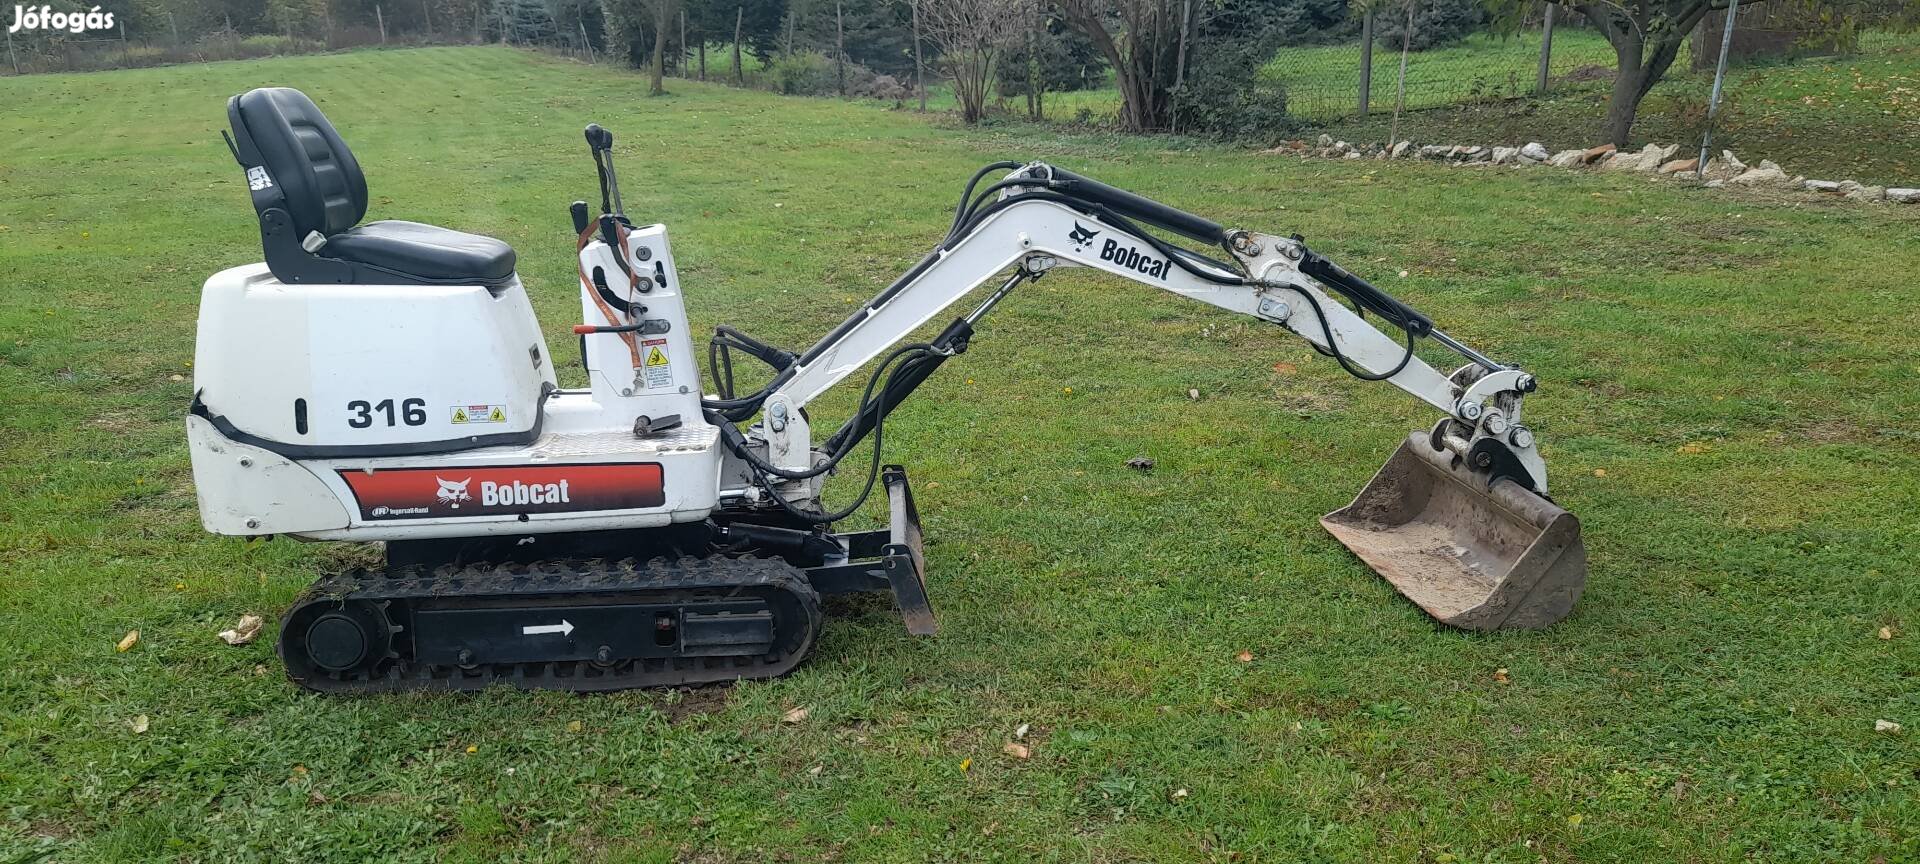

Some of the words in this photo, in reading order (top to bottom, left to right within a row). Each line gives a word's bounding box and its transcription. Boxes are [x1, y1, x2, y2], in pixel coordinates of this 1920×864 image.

[1100, 238, 1172, 281] Bobcat
[347, 397, 427, 429] 316
[481, 479, 570, 506] Bobcat
